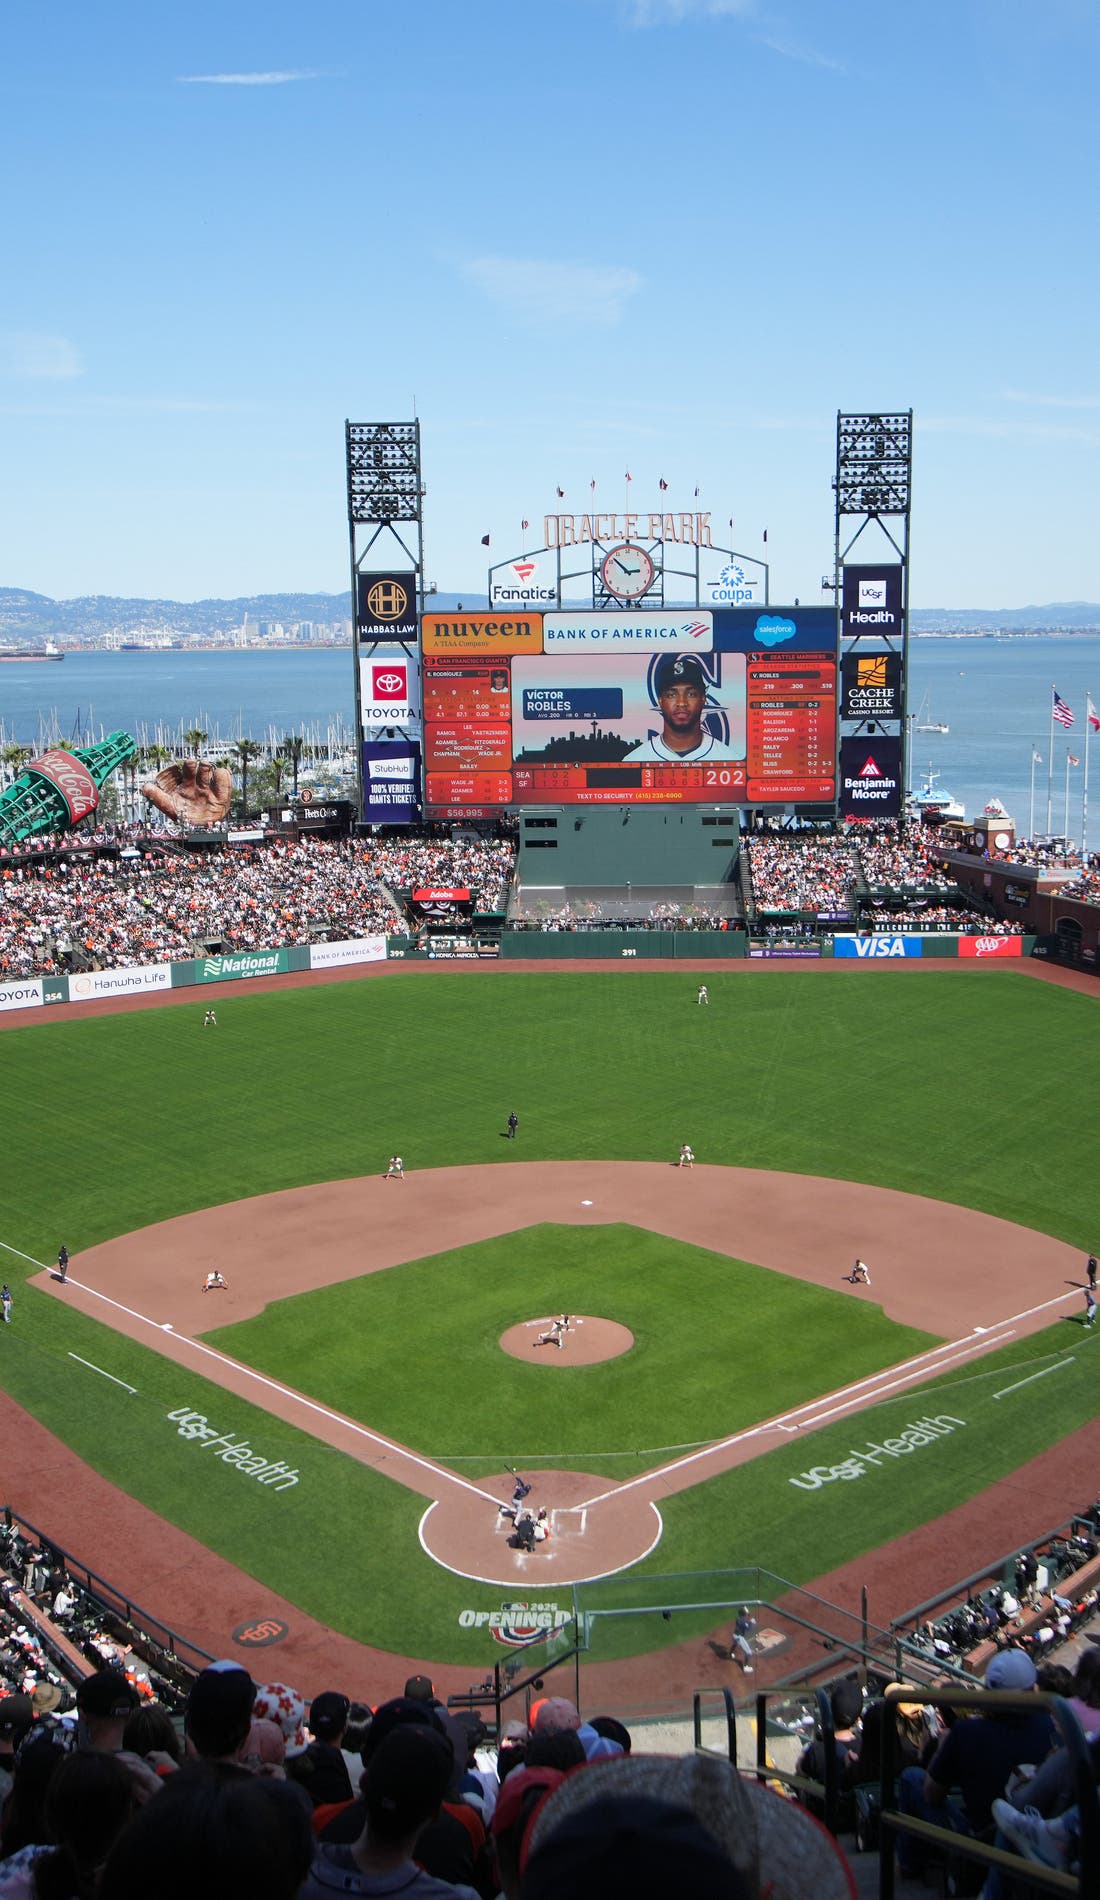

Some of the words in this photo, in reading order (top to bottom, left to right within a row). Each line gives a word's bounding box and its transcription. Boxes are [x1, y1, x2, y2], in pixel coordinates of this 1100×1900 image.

[544, 514, 638, 550] ORACLE
[648, 512, 713, 548] PARK
[493, 585, 556, 600] Fanatics
[712, 589, 752, 603] coupa
[862, 589, 882, 599] UCSF
[849, 611, 894, 623] Health
[361, 625, 395, 634] HABBAS
[397, 624, 415, 633] LAW
[433, 621, 531, 638] nuveen
[548, 629, 586, 639] BANK
[591, 629, 609, 639] OF
[612, 628, 677, 639] AMERICA
[758, 624, 793, 634] salesforce
[527, 690, 564, 700] VÍCTOR
[848, 688, 894, 698] CACHE
[528, 701, 571, 711] ROBLES
[850, 698, 892, 708] CREEK
[365, 708, 416, 718] TOYOTA
[375, 764, 408, 773] StubHub
[26, 752, 96, 814] Coca-Cola
[845, 778, 895, 790] Benjamin
[371, 784, 387, 794] 100%
[388, 784, 414, 793] VERIFIED
[852, 789, 888, 799] Moore
[369, 794, 390, 804] GIANTS
[392, 794, 416, 804] TICKETS
[304, 808, 319, 818] Peet's
[320, 808, 337, 818] Coffee
[448, 809, 482, 817] $56,995
[850, 938, 906, 957] VISA
[977, 940, 998, 950] AAA
[312, 953, 331, 961] BANK
[342, 949, 370, 957] AMERICA
[222, 953, 279, 972] National
[242, 970, 254, 978] Car
[255, 967, 276, 977] Rental
[95, 978, 142, 990] Hanwha
[145, 973, 166, 983] Life
[45, 992, 62, 1001] 354
[167, 1407, 219, 1440] UCSF
[201, 1433, 299, 1491] Health
[788, 1458, 866, 1490] UCSF
[850, 1415, 967, 1466] Health
[531, 1603, 558, 1611] 2025
[458, 1610, 551, 1628] OPENING
